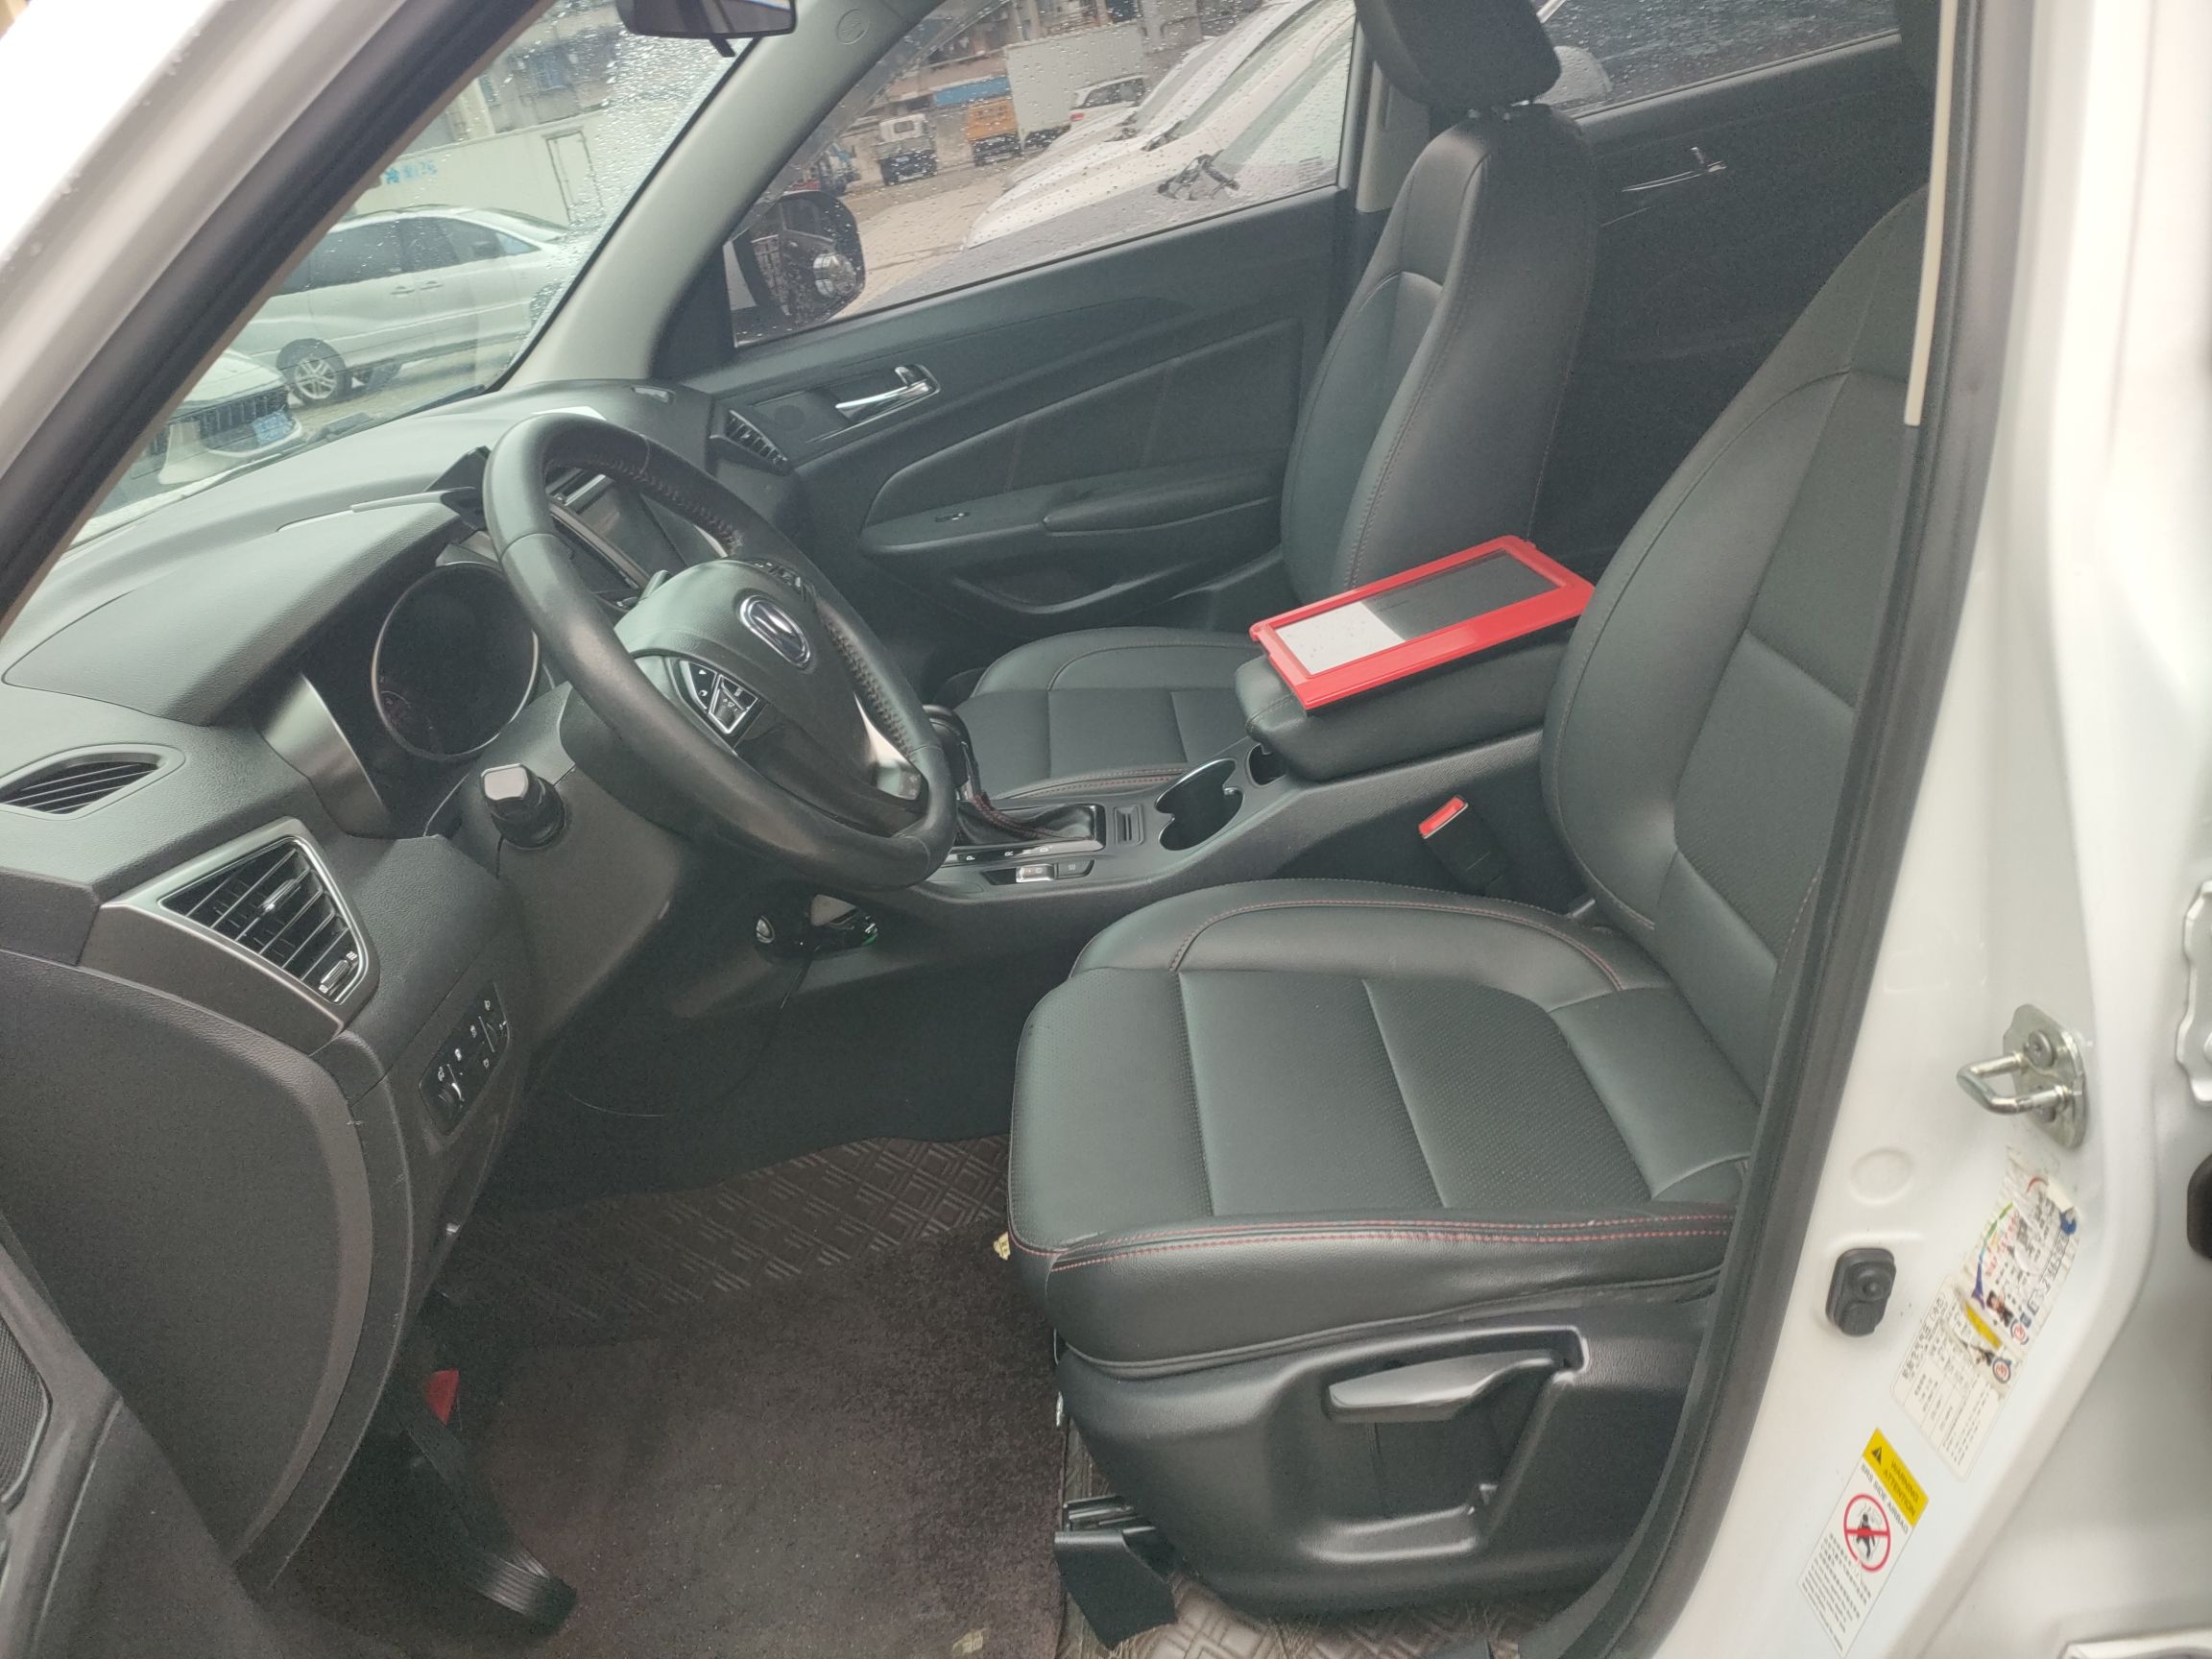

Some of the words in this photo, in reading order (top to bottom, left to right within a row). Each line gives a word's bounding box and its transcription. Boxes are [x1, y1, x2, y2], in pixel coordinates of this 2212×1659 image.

[1862, 1464, 1873, 1482] SRS
[1873, 1482, 1887, 1503] SIDE
[1887, 1503, 1909, 1534] AIRBAG
[1884, 1469, 1916, 1517] ATTENTION
[1891, 1459, 1919, 1503] WARNING
